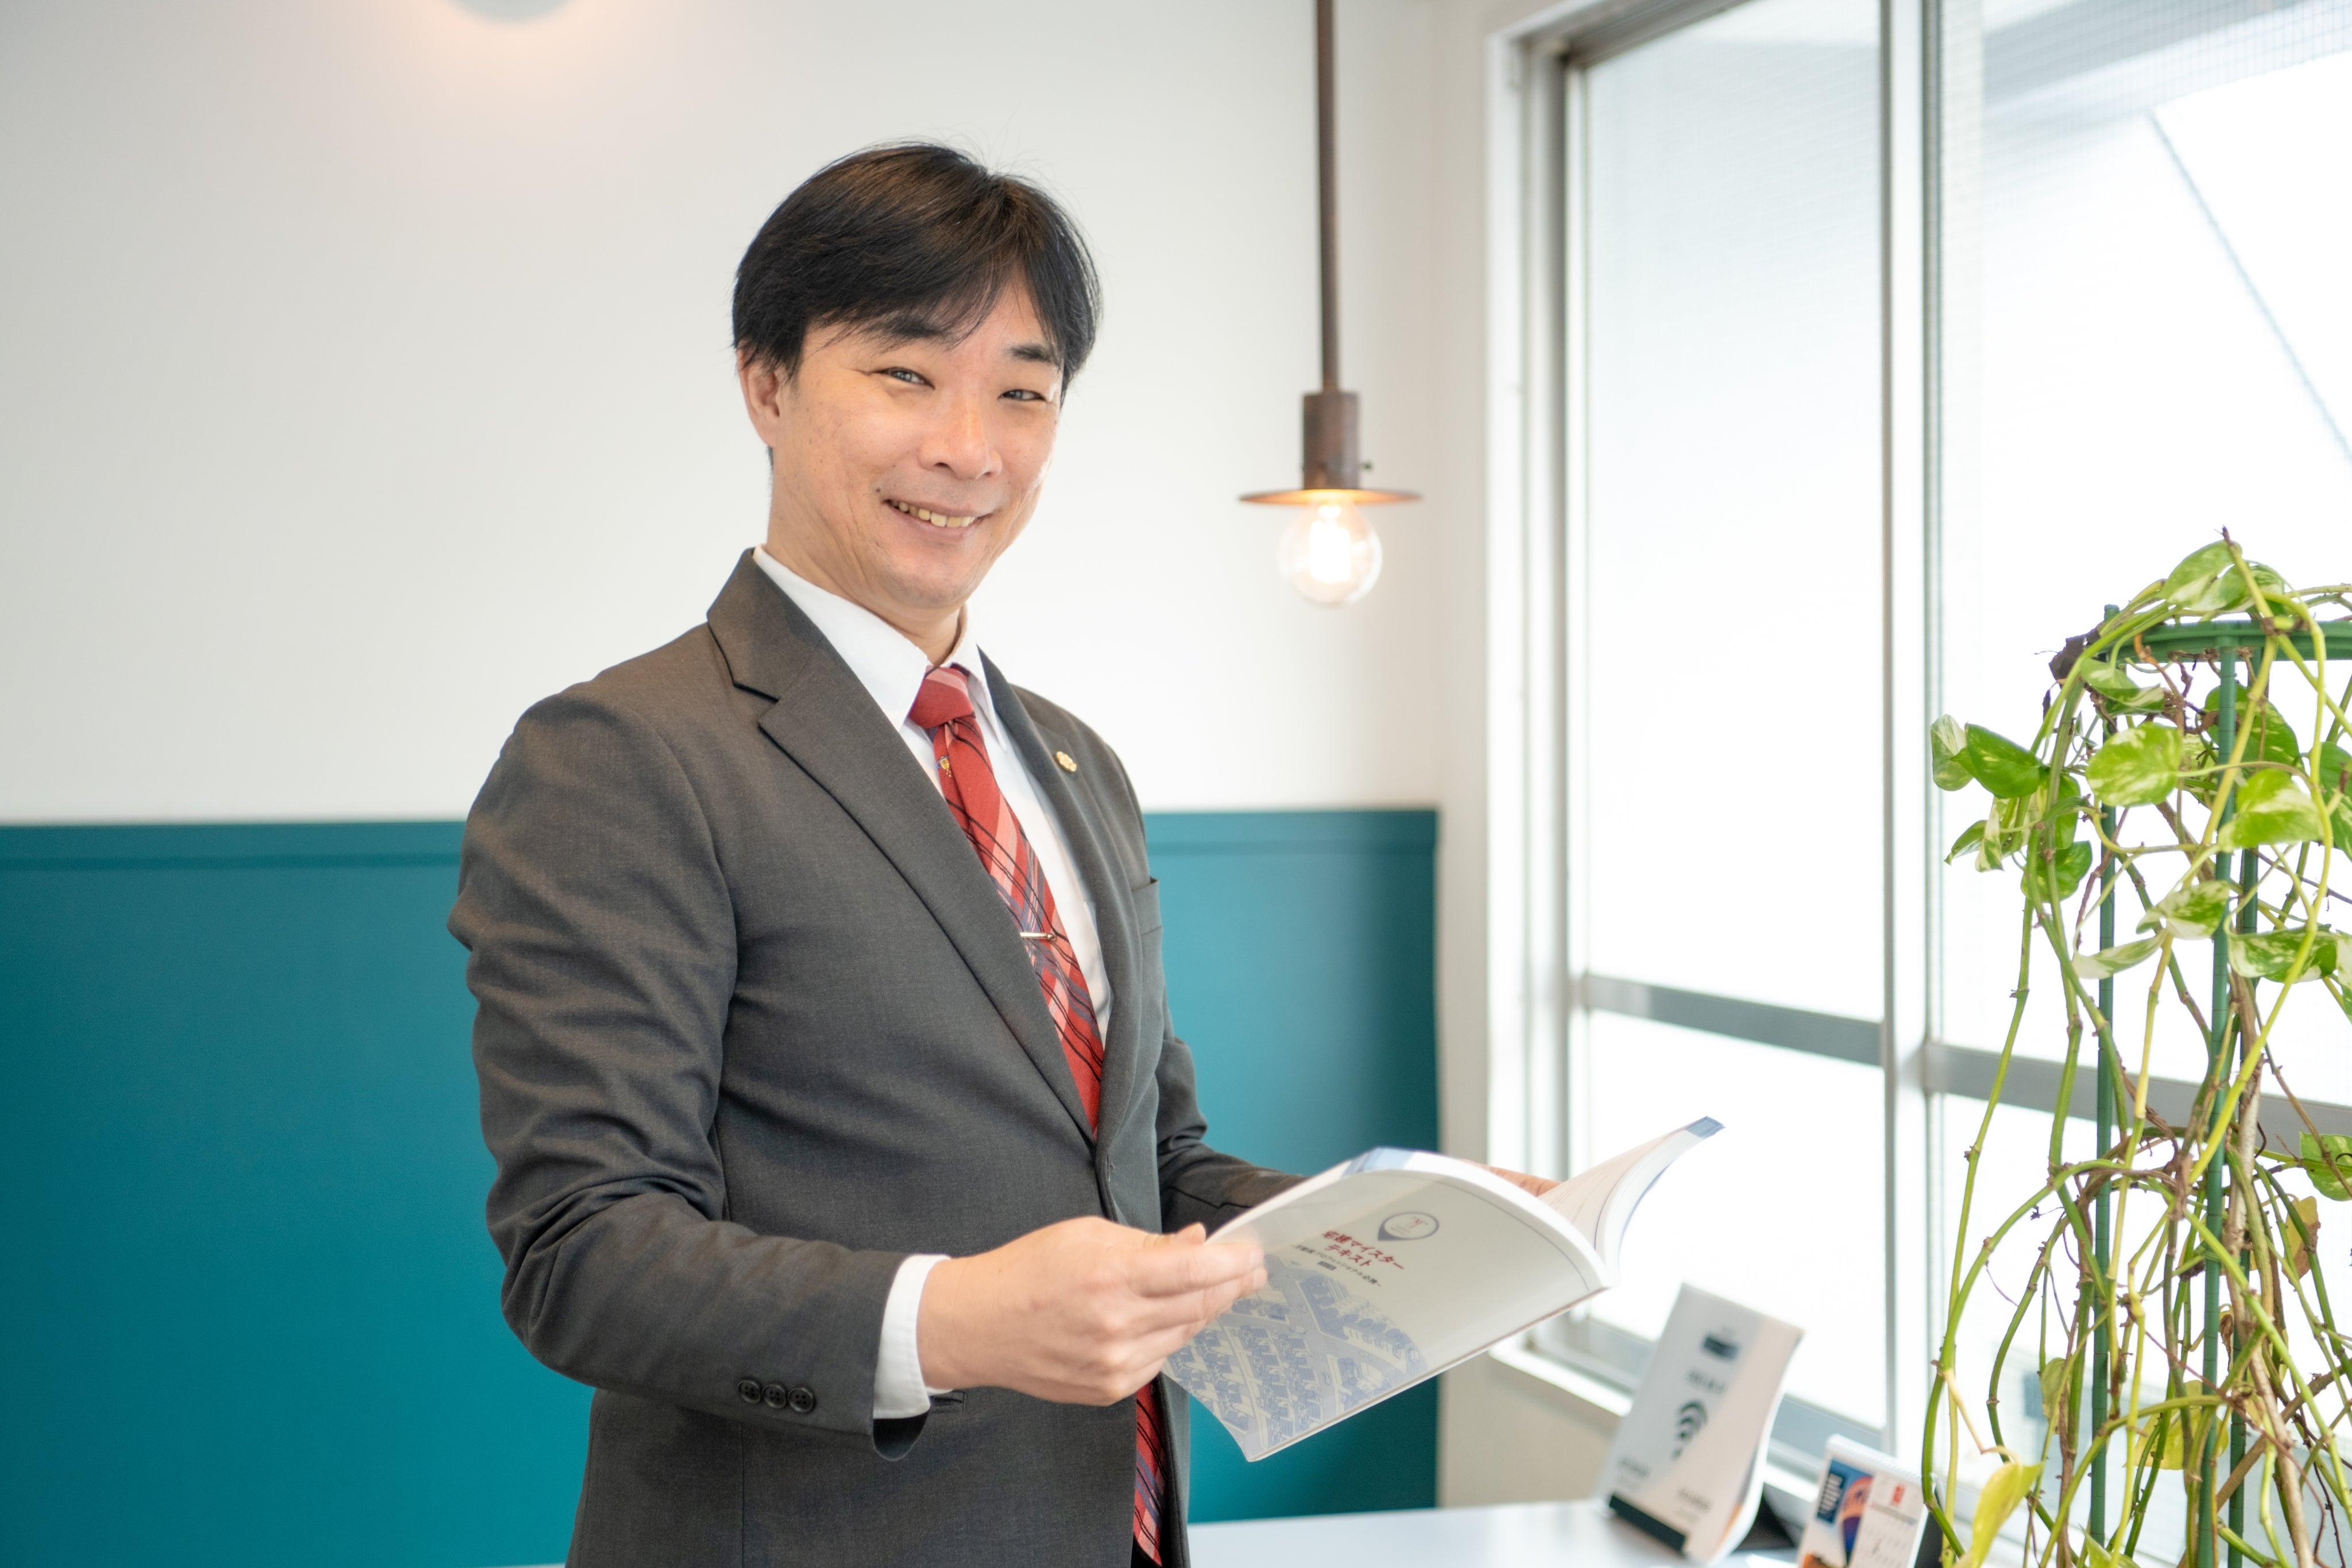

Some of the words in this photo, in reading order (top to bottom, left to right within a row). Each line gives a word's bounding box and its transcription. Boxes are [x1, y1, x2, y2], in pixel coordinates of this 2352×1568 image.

[1322, 1231, 1404, 1269] 宅建マイスター
[1325, 1245, 1372, 1267] テキスト
